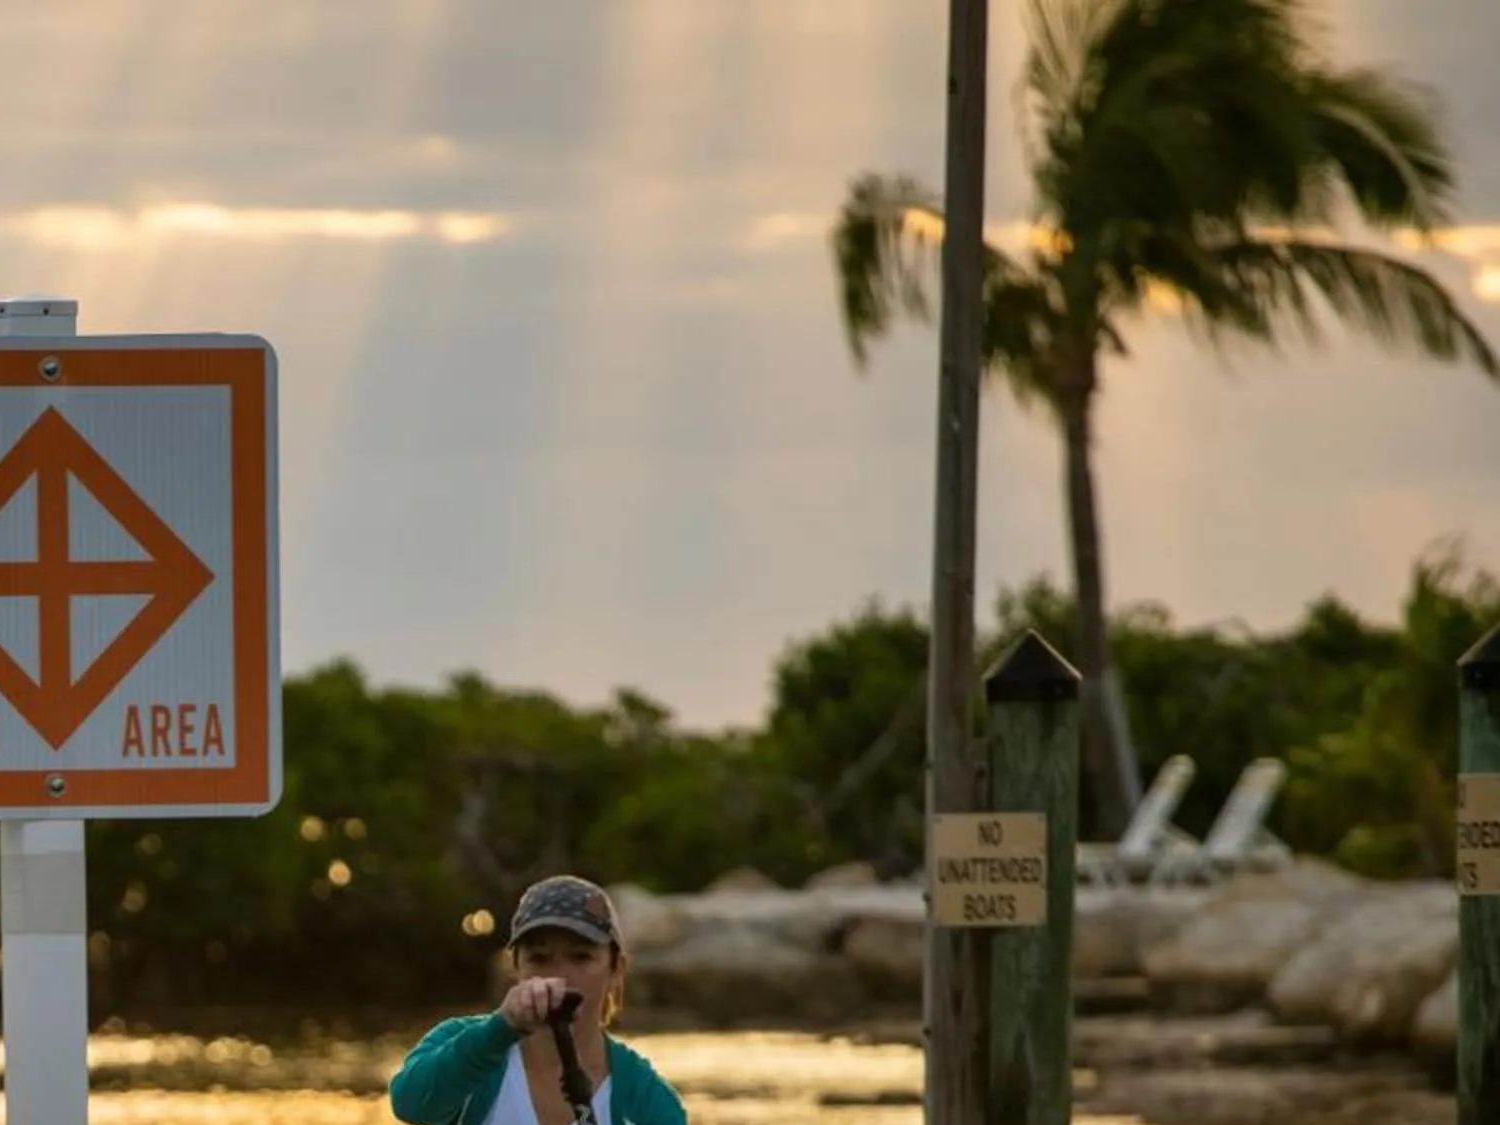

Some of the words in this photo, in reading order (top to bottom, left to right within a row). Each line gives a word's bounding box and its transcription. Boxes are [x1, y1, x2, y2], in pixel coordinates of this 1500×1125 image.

[121, 703, 226, 758] AREA
[977, 820, 1004, 847] NO
[937, 857, 1043, 884] UNATTENDED
[962, 893, 1018, 921] BOATS
